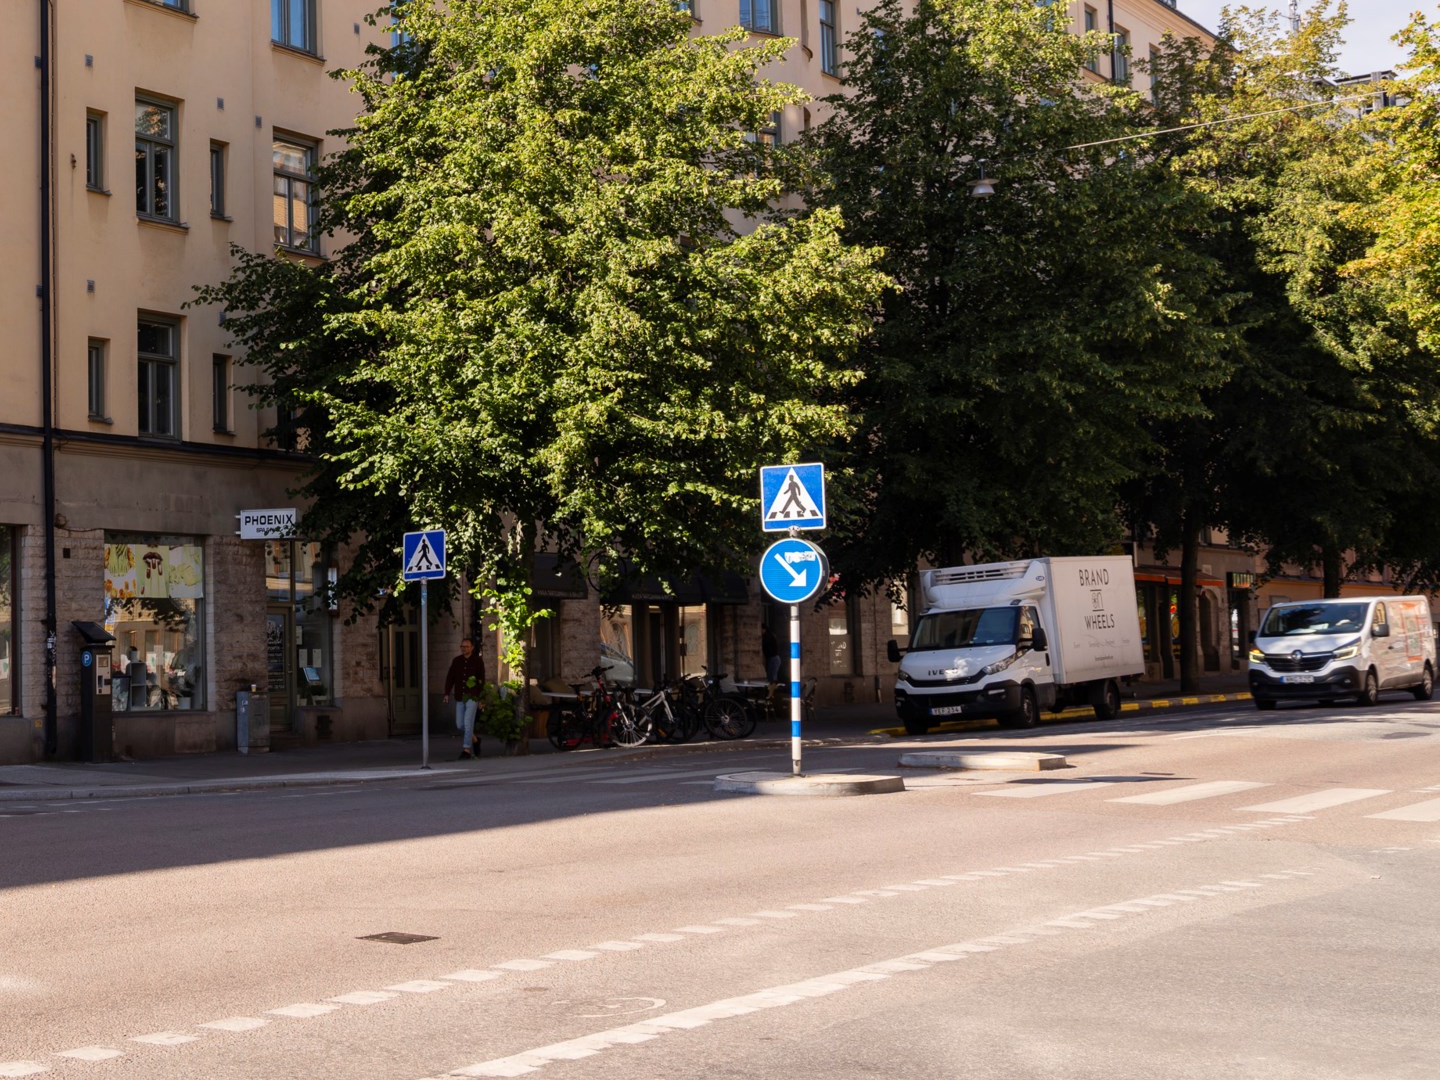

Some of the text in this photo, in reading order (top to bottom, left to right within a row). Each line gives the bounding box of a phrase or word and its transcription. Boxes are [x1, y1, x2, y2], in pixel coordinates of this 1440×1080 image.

[244, 514, 293, 526] PHOENIX
[1078, 568, 1109, 586] BRAND
[1084, 613, 1115, 630] WHEELS
